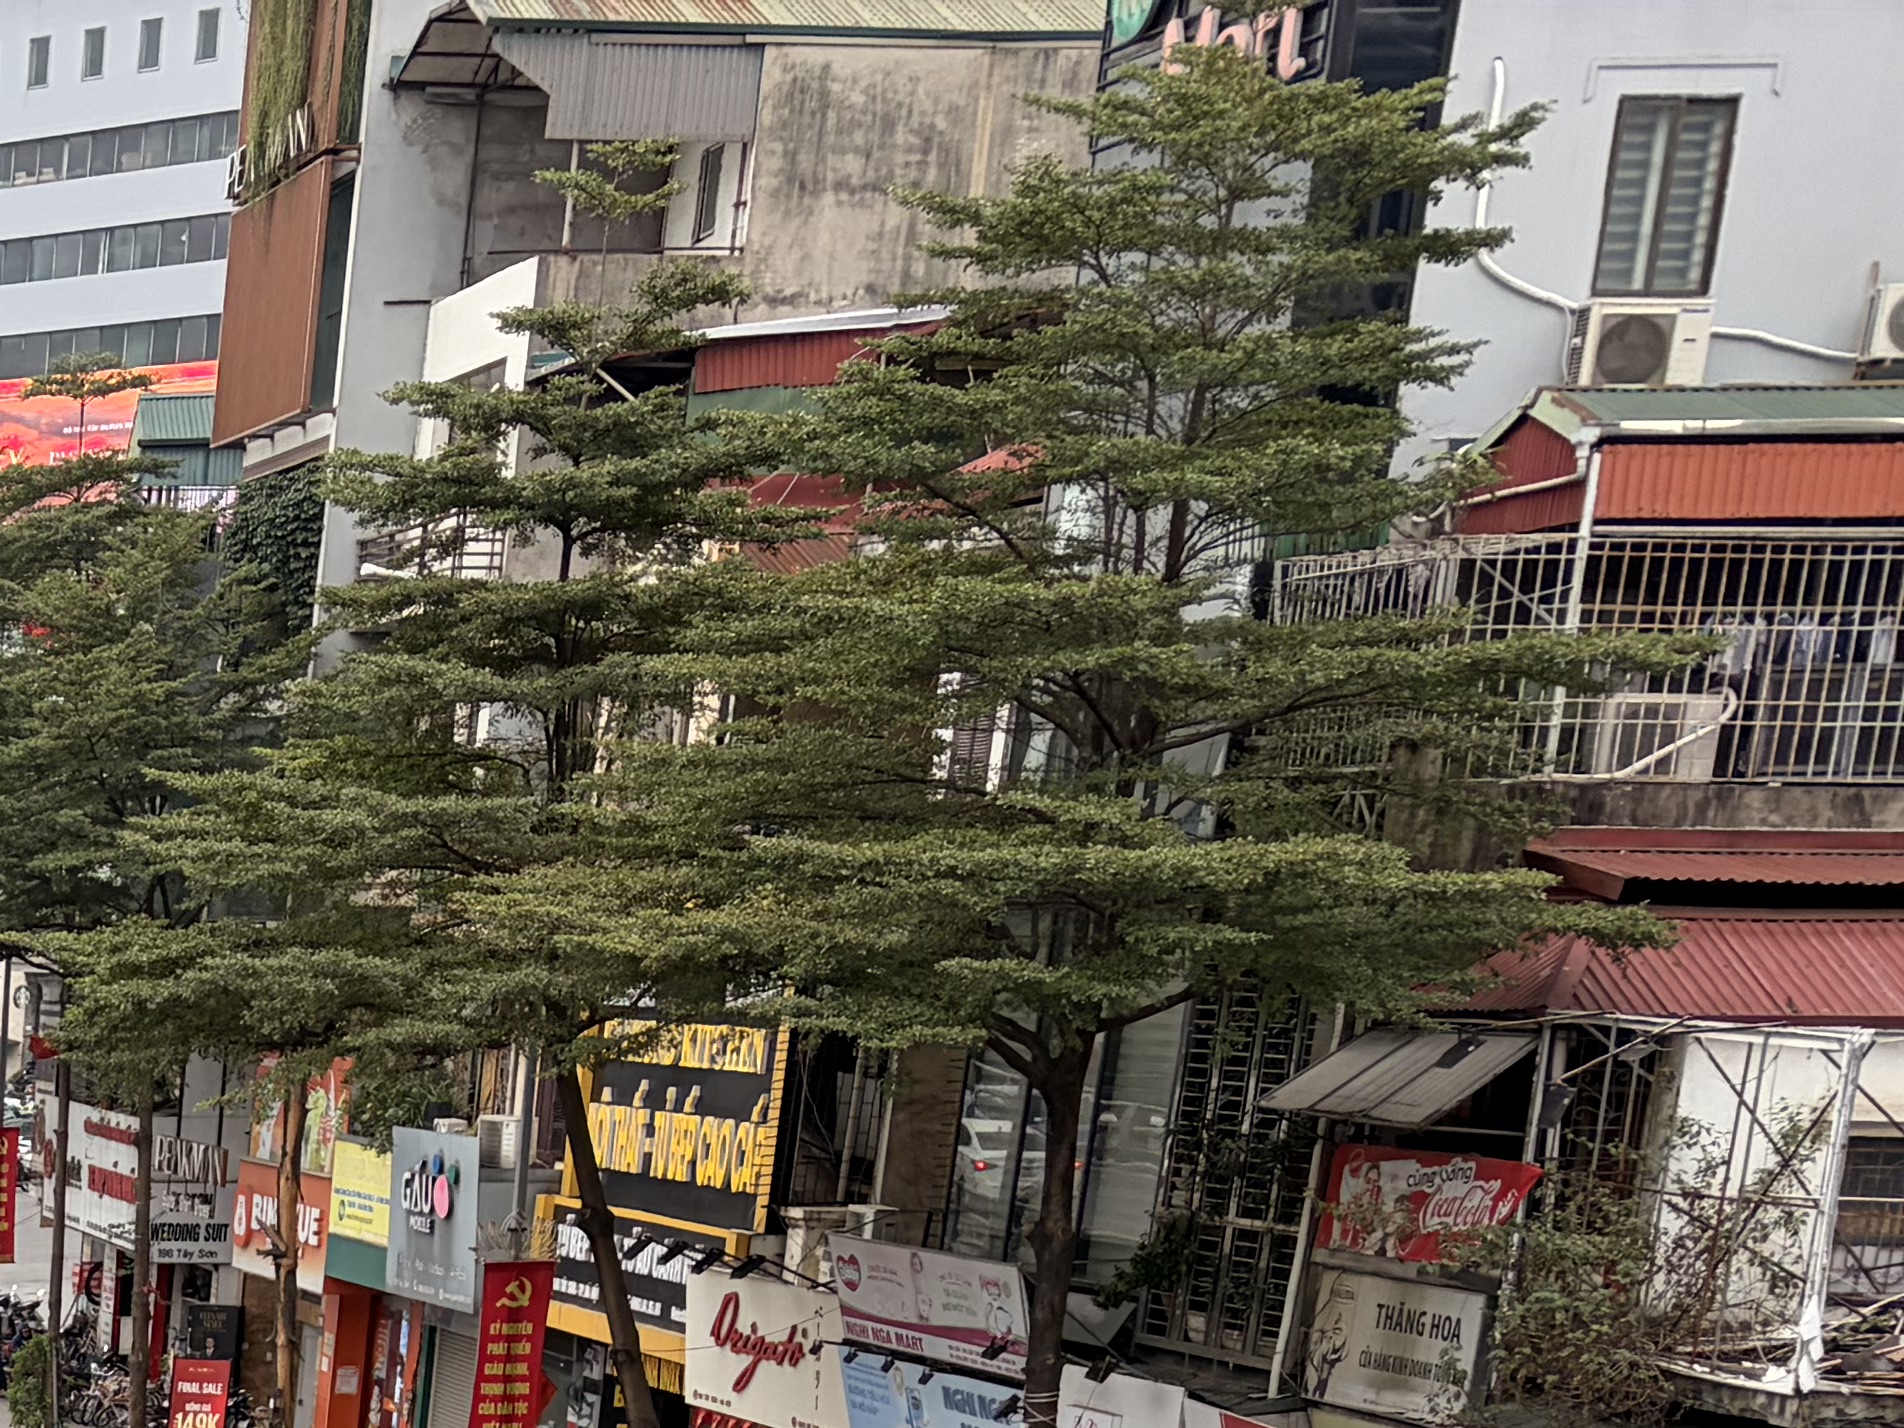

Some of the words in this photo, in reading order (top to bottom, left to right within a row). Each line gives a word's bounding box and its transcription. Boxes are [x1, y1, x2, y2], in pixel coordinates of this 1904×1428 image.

[150, 1222, 200, 1243] WEDDING
[203, 1223, 229, 1243] SUIT
[1376, 1302, 1427, 1337] THĂNG
[1429, 1313, 1462, 1345] HOA
[202, 1382, 223, 1395] SALE
